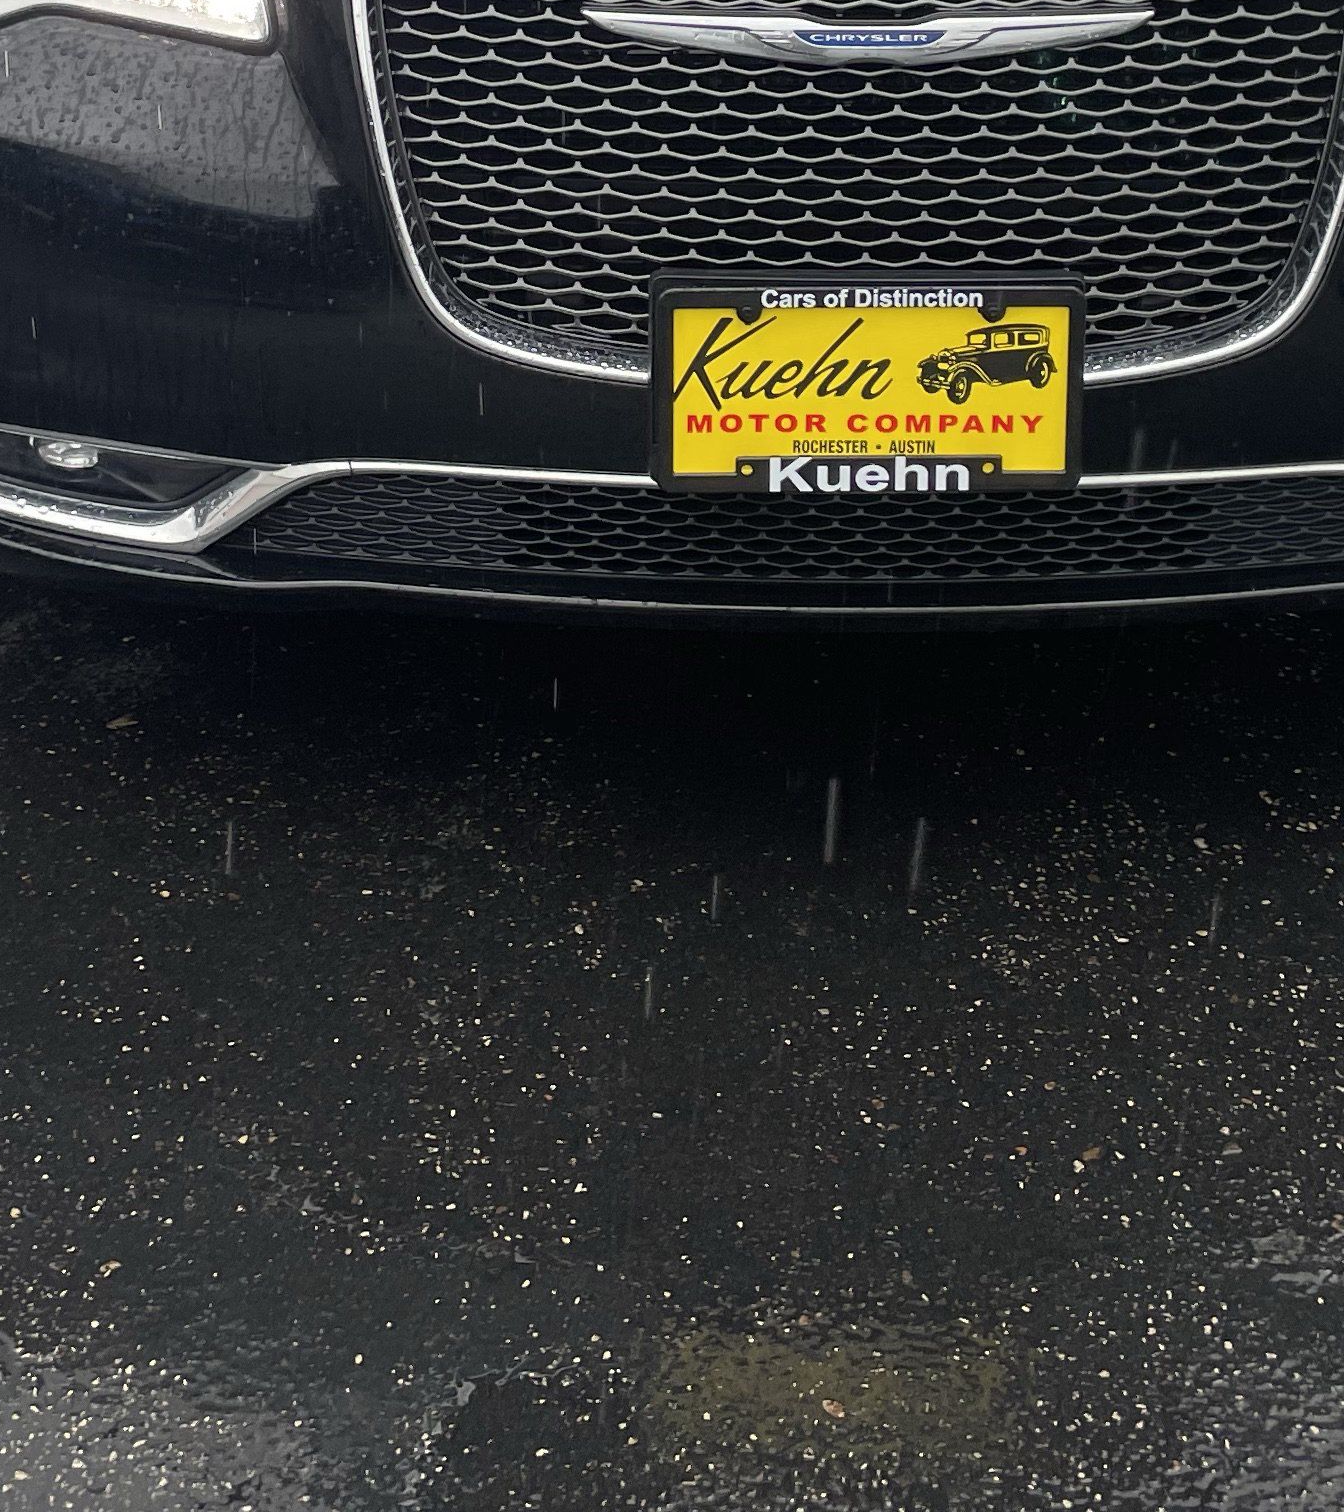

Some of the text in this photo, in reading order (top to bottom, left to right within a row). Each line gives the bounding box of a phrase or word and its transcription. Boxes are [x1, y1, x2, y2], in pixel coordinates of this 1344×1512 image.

[810, 34, 928, 42] CHRYSLER
[761, 289, 984, 308] Cars of Distinction
[673, 316, 893, 412] Kuehn
[686, 413, 1045, 434] MOTOR COMPANY
[792, 440, 936, 454] ROCHESTER AUSTIN
[769, 456, 971, 493] Kuehn
